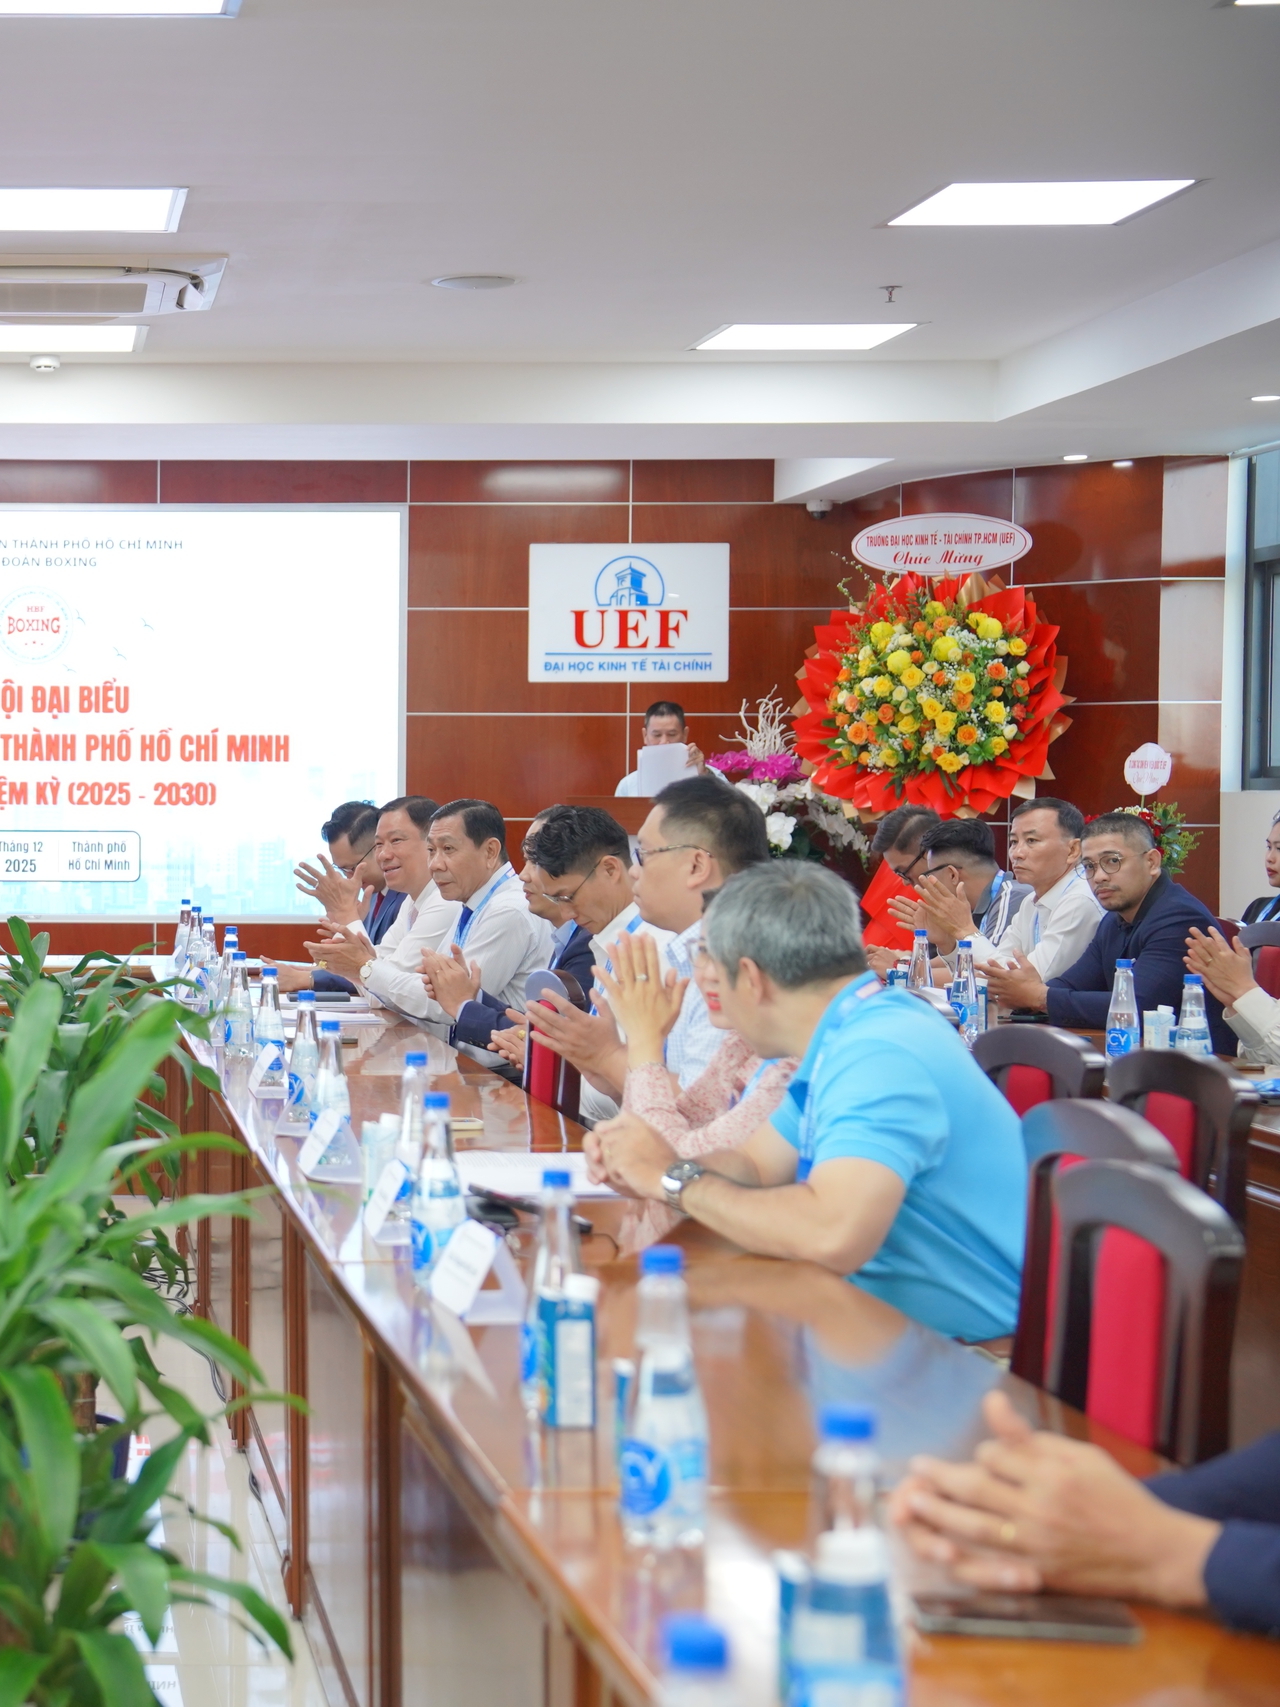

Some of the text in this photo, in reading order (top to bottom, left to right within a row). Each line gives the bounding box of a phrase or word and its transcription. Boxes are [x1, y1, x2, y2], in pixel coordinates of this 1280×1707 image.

[12, 537, 58, 549] THÀNH
[119, 537, 141, 549] CHÍ
[146, 540, 183, 549] MINH
[890, 534, 900, 549] ĐẠI
[901, 534, 914, 548] HỌC
[915, 534, 929, 545] KINH
[930, 530, 938, 545] TẾ
[943, 530, 952, 544] TÀI
[954, 530, 972, 544] CHÍNH
[974, 533, 997, 544] TP.HCM
[999, 532, 1015, 546] (UEF)
[2, 554, 40, 566] ĐOÀN
[45, 557, 97, 567] BOXING
[893, 550, 984, 566] Chúc Mừng
[7, 616, 61, 635] BOXING
[570, 609, 688, 649] UEF
[544, 658, 712, 674] ĐẠI HỌC KINH TẾ TÀI CHÍNH
[31, 685, 70, 719] ĐẠI
[79, 678, 129, 713] BIỂU
[0, 727, 76, 761] THÀNH
[86, 727, 134, 761] PHỐ
[141, 727, 172, 761] HỒ
[180, 727, 219, 762] CHÍ
[227, 735, 289, 762] MINH
[36, 776, 60, 805] KỲ
[68, 782, 131, 805] (2025
[154, 782, 217, 806] 2030)
[33, 841, 43, 852] 12
[72, 839, 127, 854] Thành phố
[5, 859, 37, 873] 2025
[85, 858, 100, 870] Chí
[104, 859, 130, 871] Minh
[1108, 1033, 1128, 1046] CY
